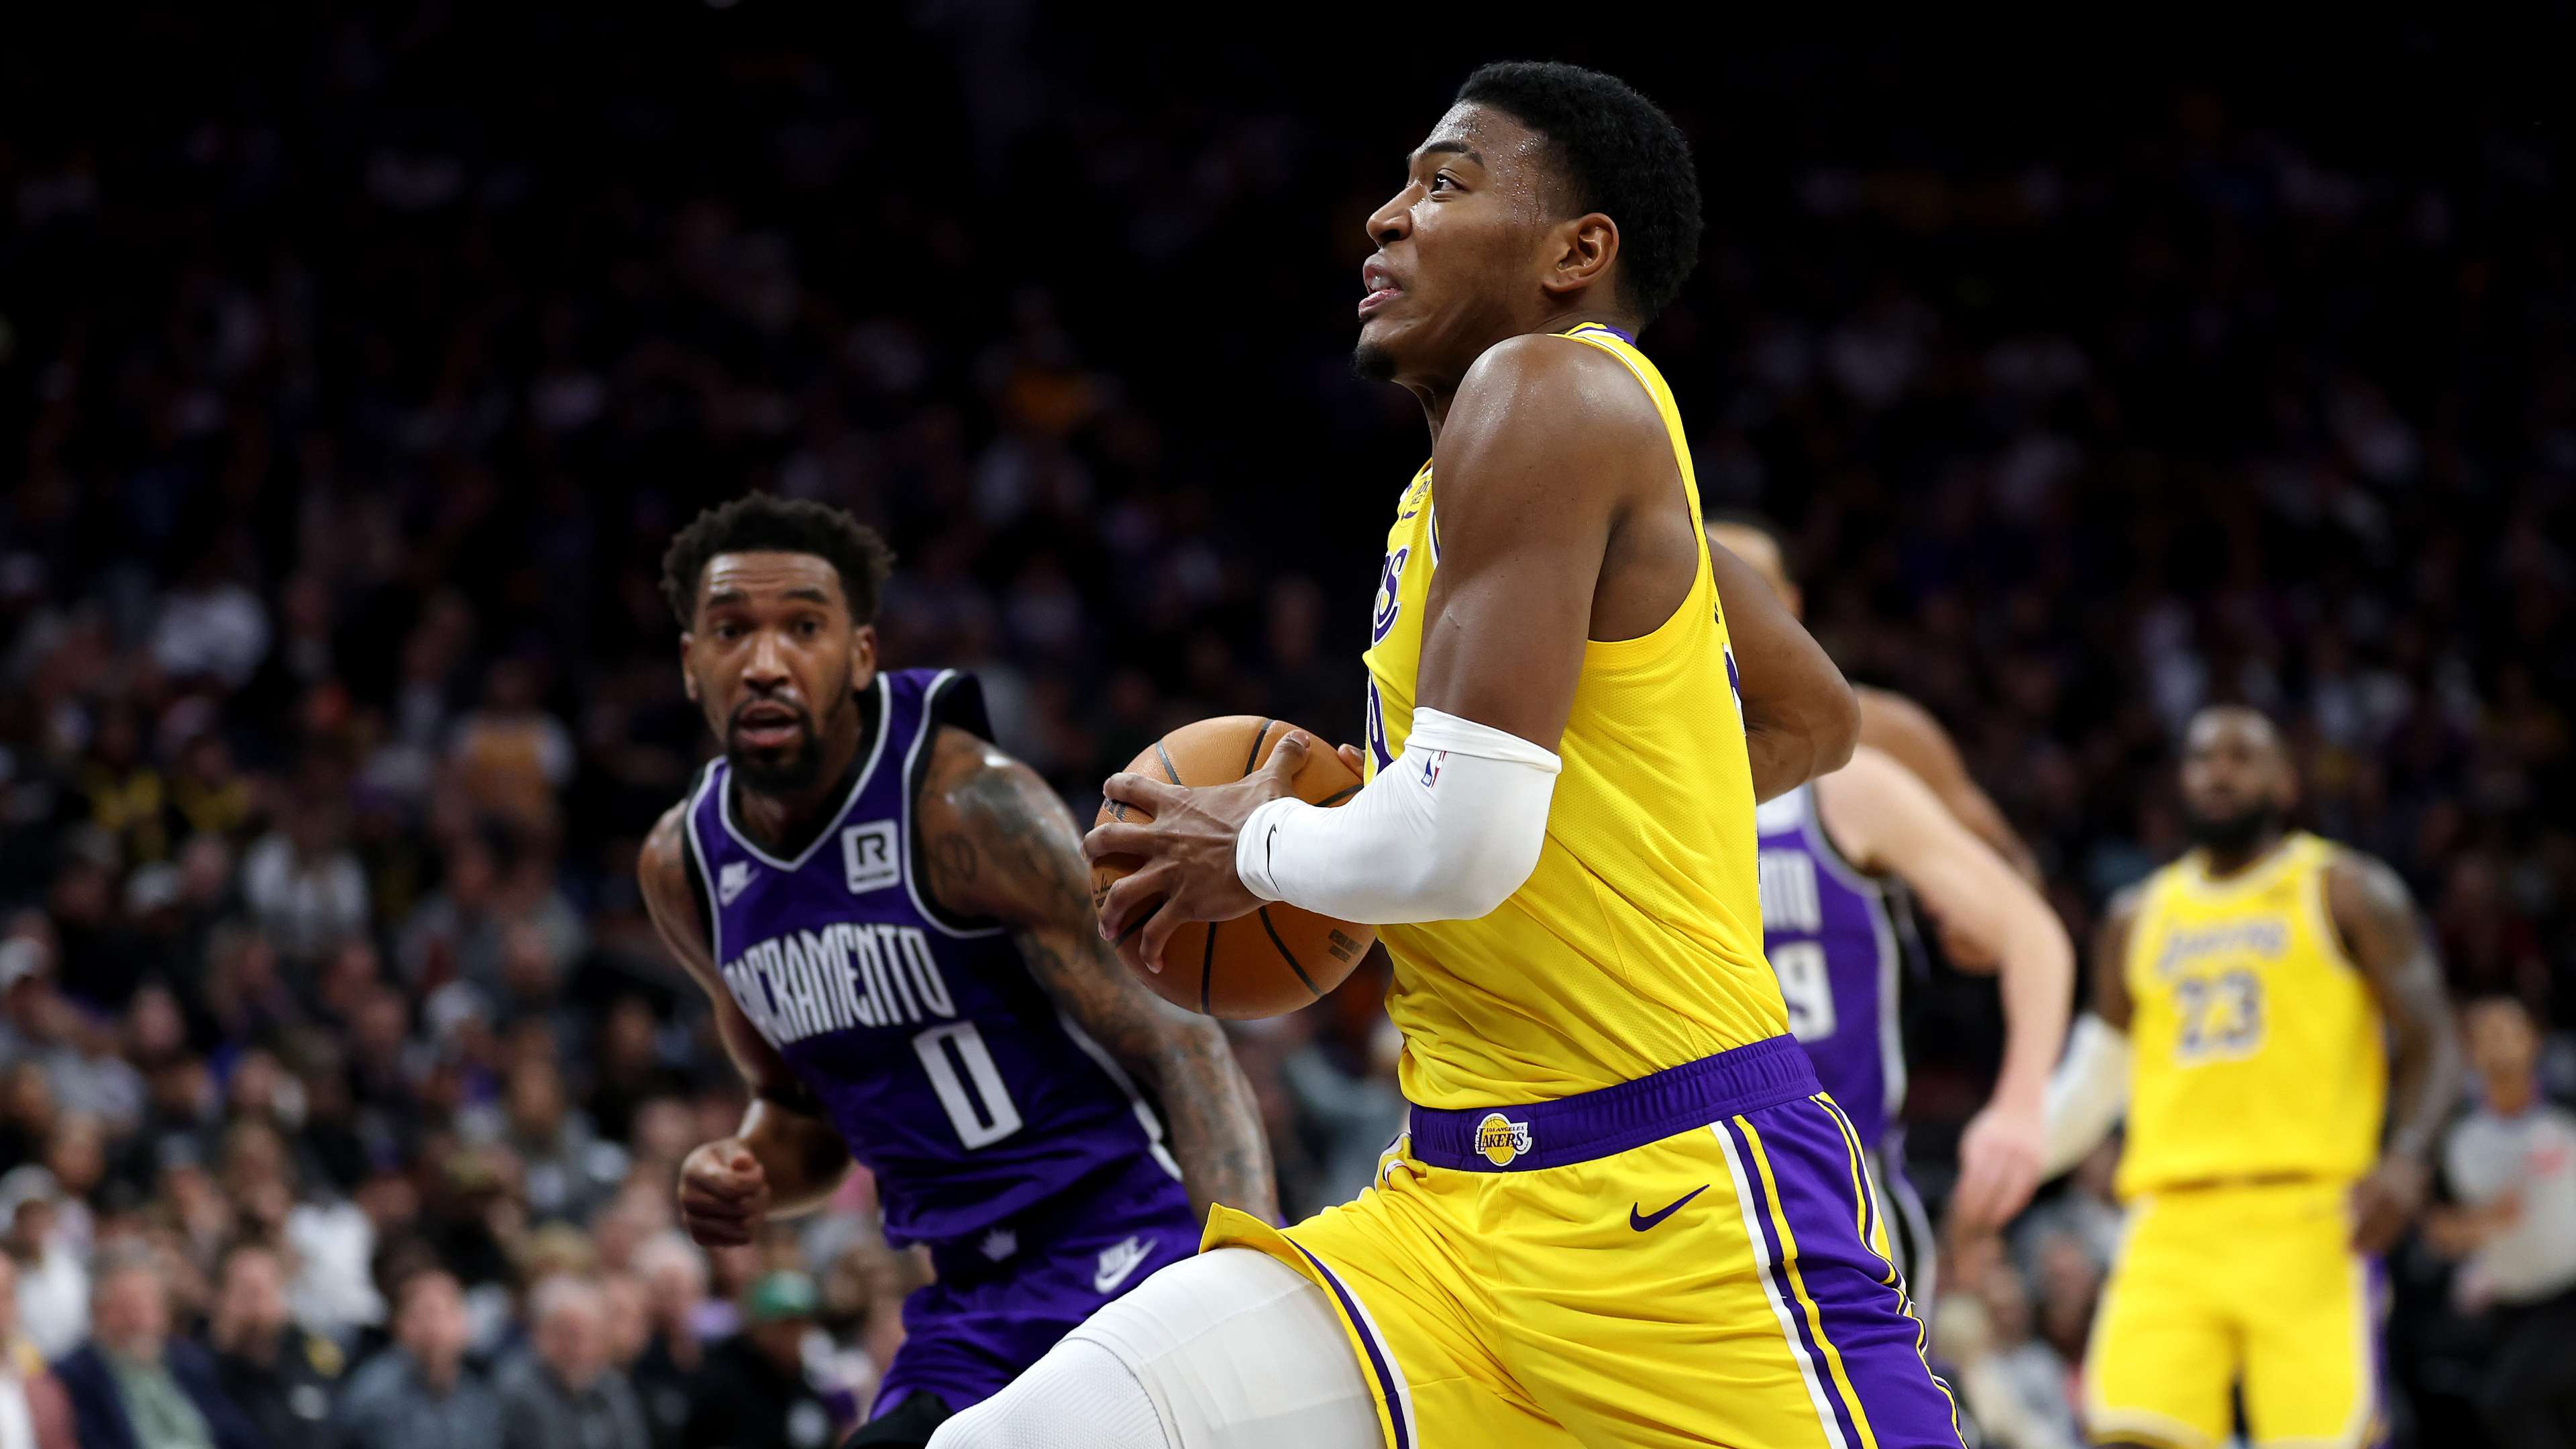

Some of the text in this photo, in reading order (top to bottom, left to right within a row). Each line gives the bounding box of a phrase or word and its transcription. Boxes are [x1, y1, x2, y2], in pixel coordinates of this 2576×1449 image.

[856, 832, 887, 867] R
[2176, 971, 2265, 1068] 23
[912, 1022, 1023, 1151] 0
[1477, 1128, 1529, 1152] LAKERS
